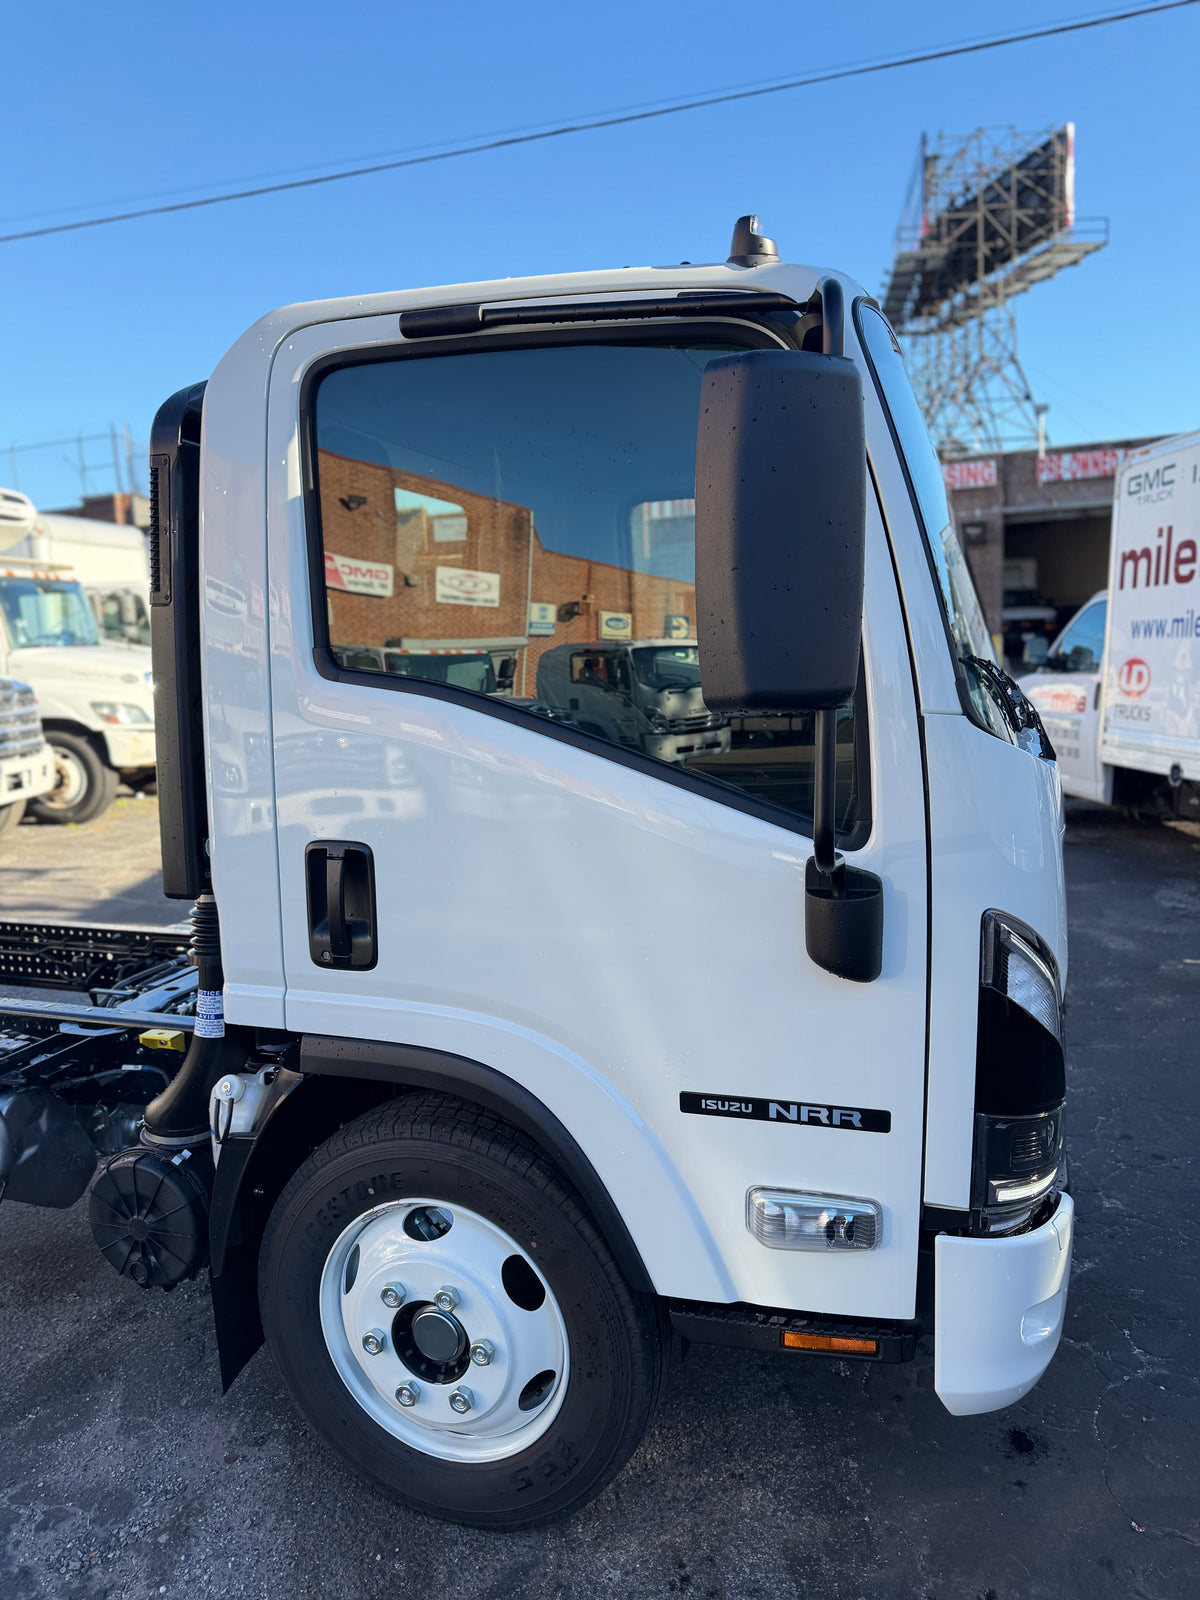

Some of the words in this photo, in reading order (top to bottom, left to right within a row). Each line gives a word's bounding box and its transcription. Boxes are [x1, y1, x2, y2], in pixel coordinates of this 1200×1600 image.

[1127, 463, 1177, 496] GMC
[1119, 526, 1197, 590] mile
[1114, 703, 1151, 723] TRUCKS
[701, 1098, 752, 1113] ISUZU
[768, 1102, 863, 1128] NRR
